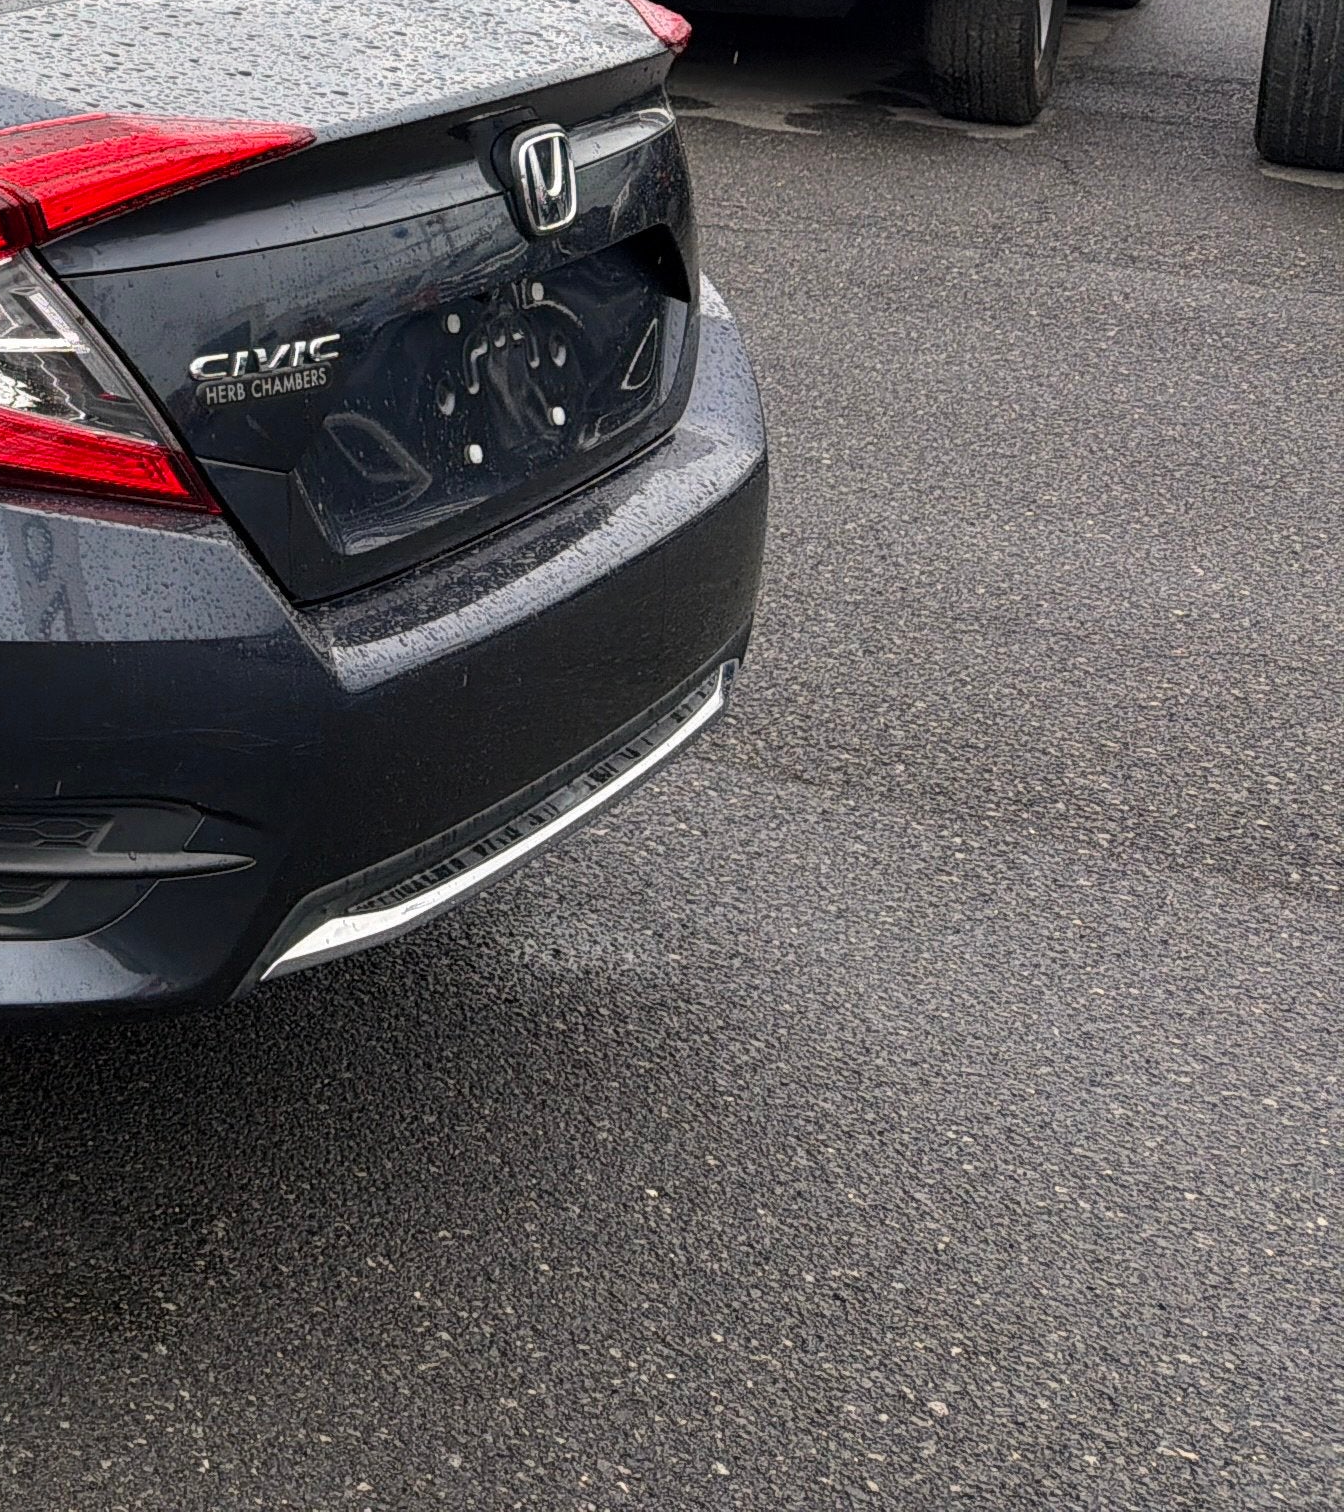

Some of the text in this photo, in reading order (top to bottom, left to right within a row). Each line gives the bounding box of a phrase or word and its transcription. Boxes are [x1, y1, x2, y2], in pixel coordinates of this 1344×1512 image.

[188, 333, 341, 381] CIVIC
[205, 367, 328, 405] HERB CHAMBERS
